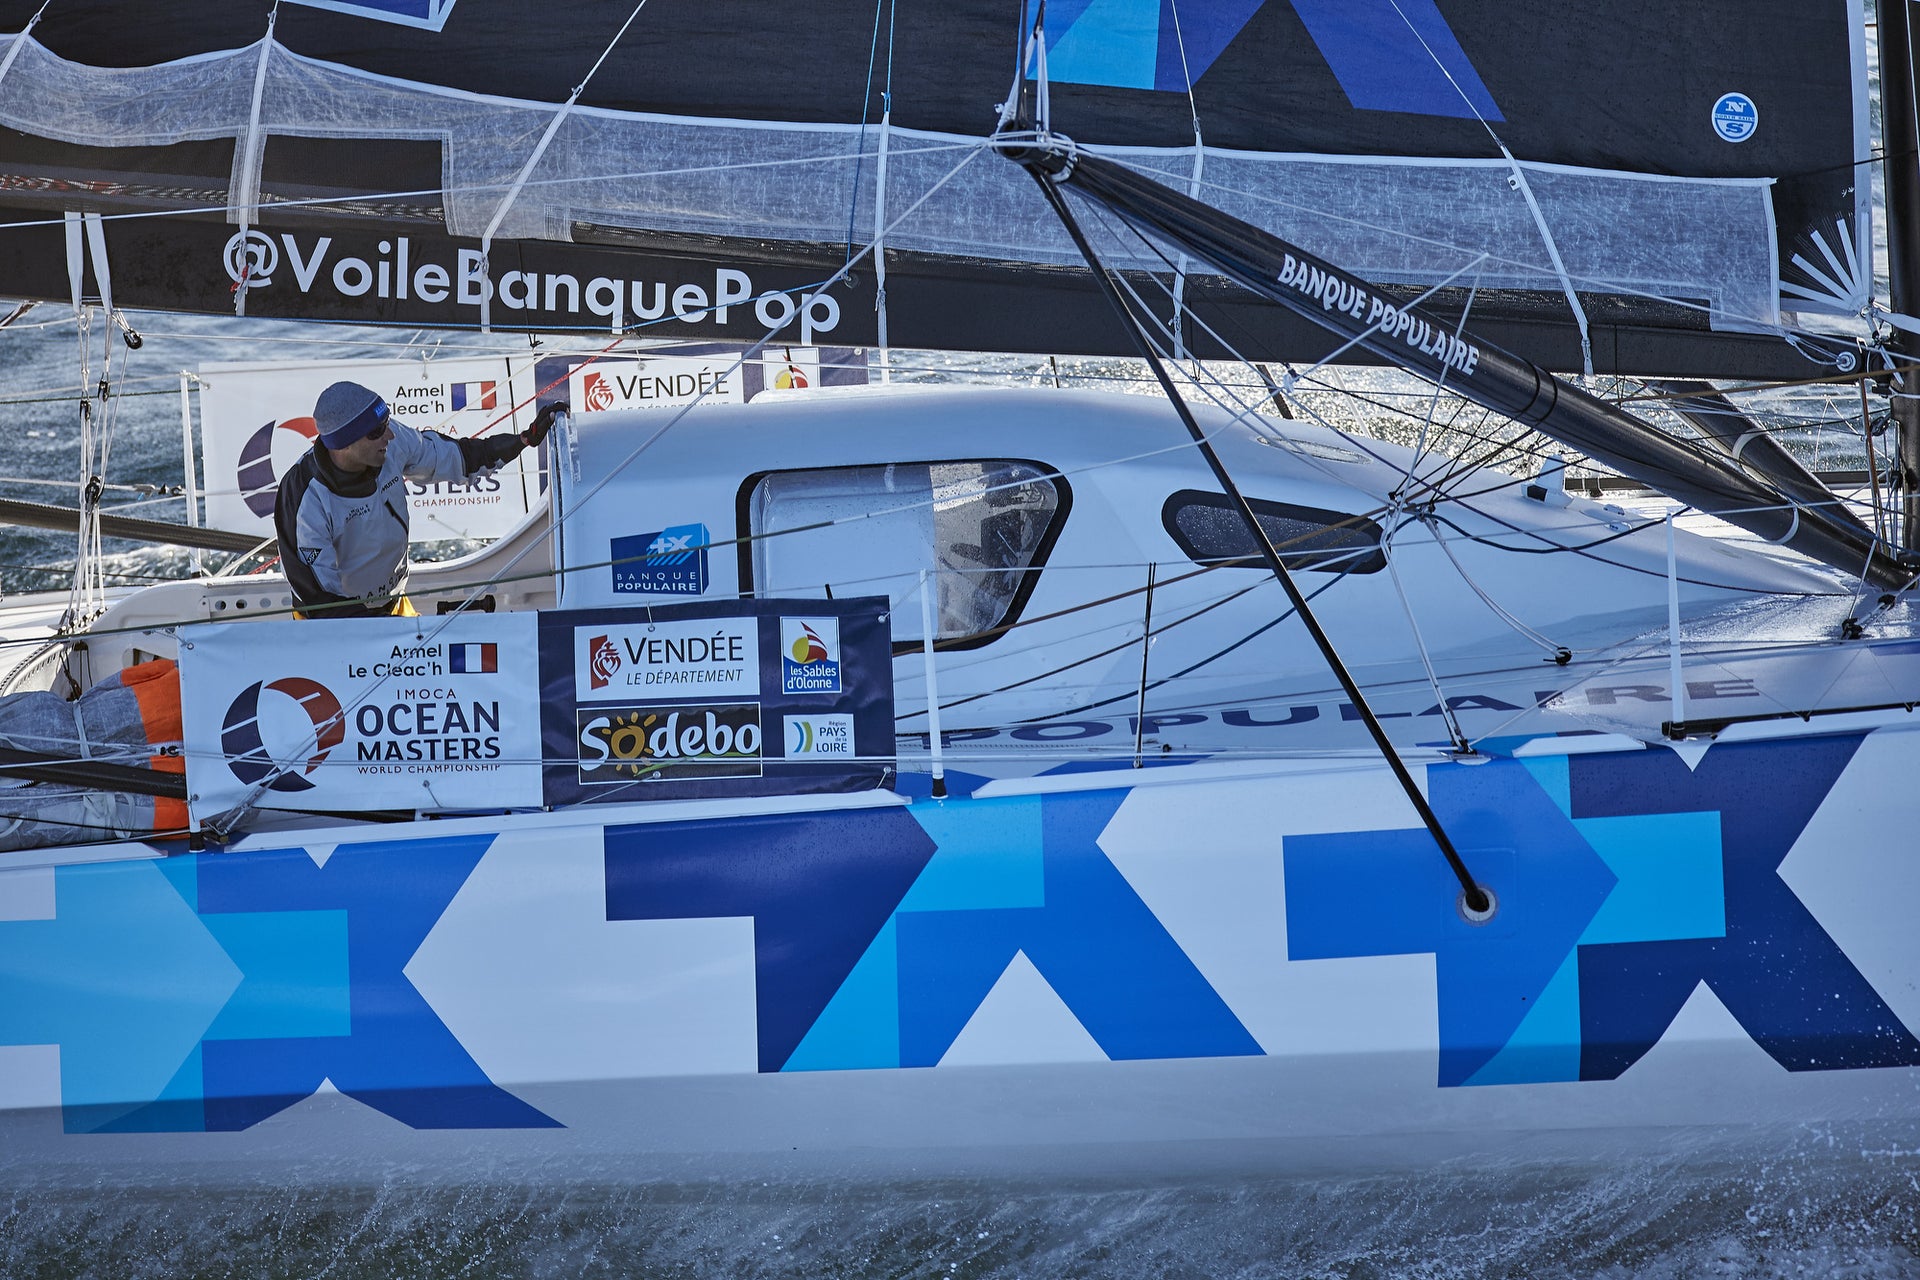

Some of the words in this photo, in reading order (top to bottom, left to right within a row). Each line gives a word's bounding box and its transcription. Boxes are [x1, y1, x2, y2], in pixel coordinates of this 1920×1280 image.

[223, 230, 840, 346] @VoileBanquePop
[1277, 253, 1366, 320] BANQUE
[1366, 296, 1480, 376] POPULAIRE
[395, 383, 444, 398] Armel
[616, 366, 729, 400] VENDÉE
[413, 495, 502, 508] CHAMPIONSHIP
[616, 571, 697, 581] BANQUE
[617, 582, 698, 592] POPULAIRE
[390, 643, 443, 660] Armel
[624, 631, 744, 665] VENDÉE
[348, 664, 368, 679] Le
[373, 661, 443, 678] Cleac'h
[626, 672, 642, 685] LE
[645, 668, 744, 685] DÉPARTEMENT
[790, 665, 803, 676] les
[803, 664, 837, 677] Sables
[787, 677, 832, 689] d'Olonne
[396, 688, 457, 700] IMOCA
[355, 701, 500, 737] OCEAN
[819, 727, 847, 737] PAYS
[357, 736, 501, 761] MASTERS
[580, 712, 761, 771] Sodebo
[816, 742, 848, 753] LOIRE
[357, 765, 402, 775] WORLD
[408, 764, 502, 775] CHAMPIONSHIP
